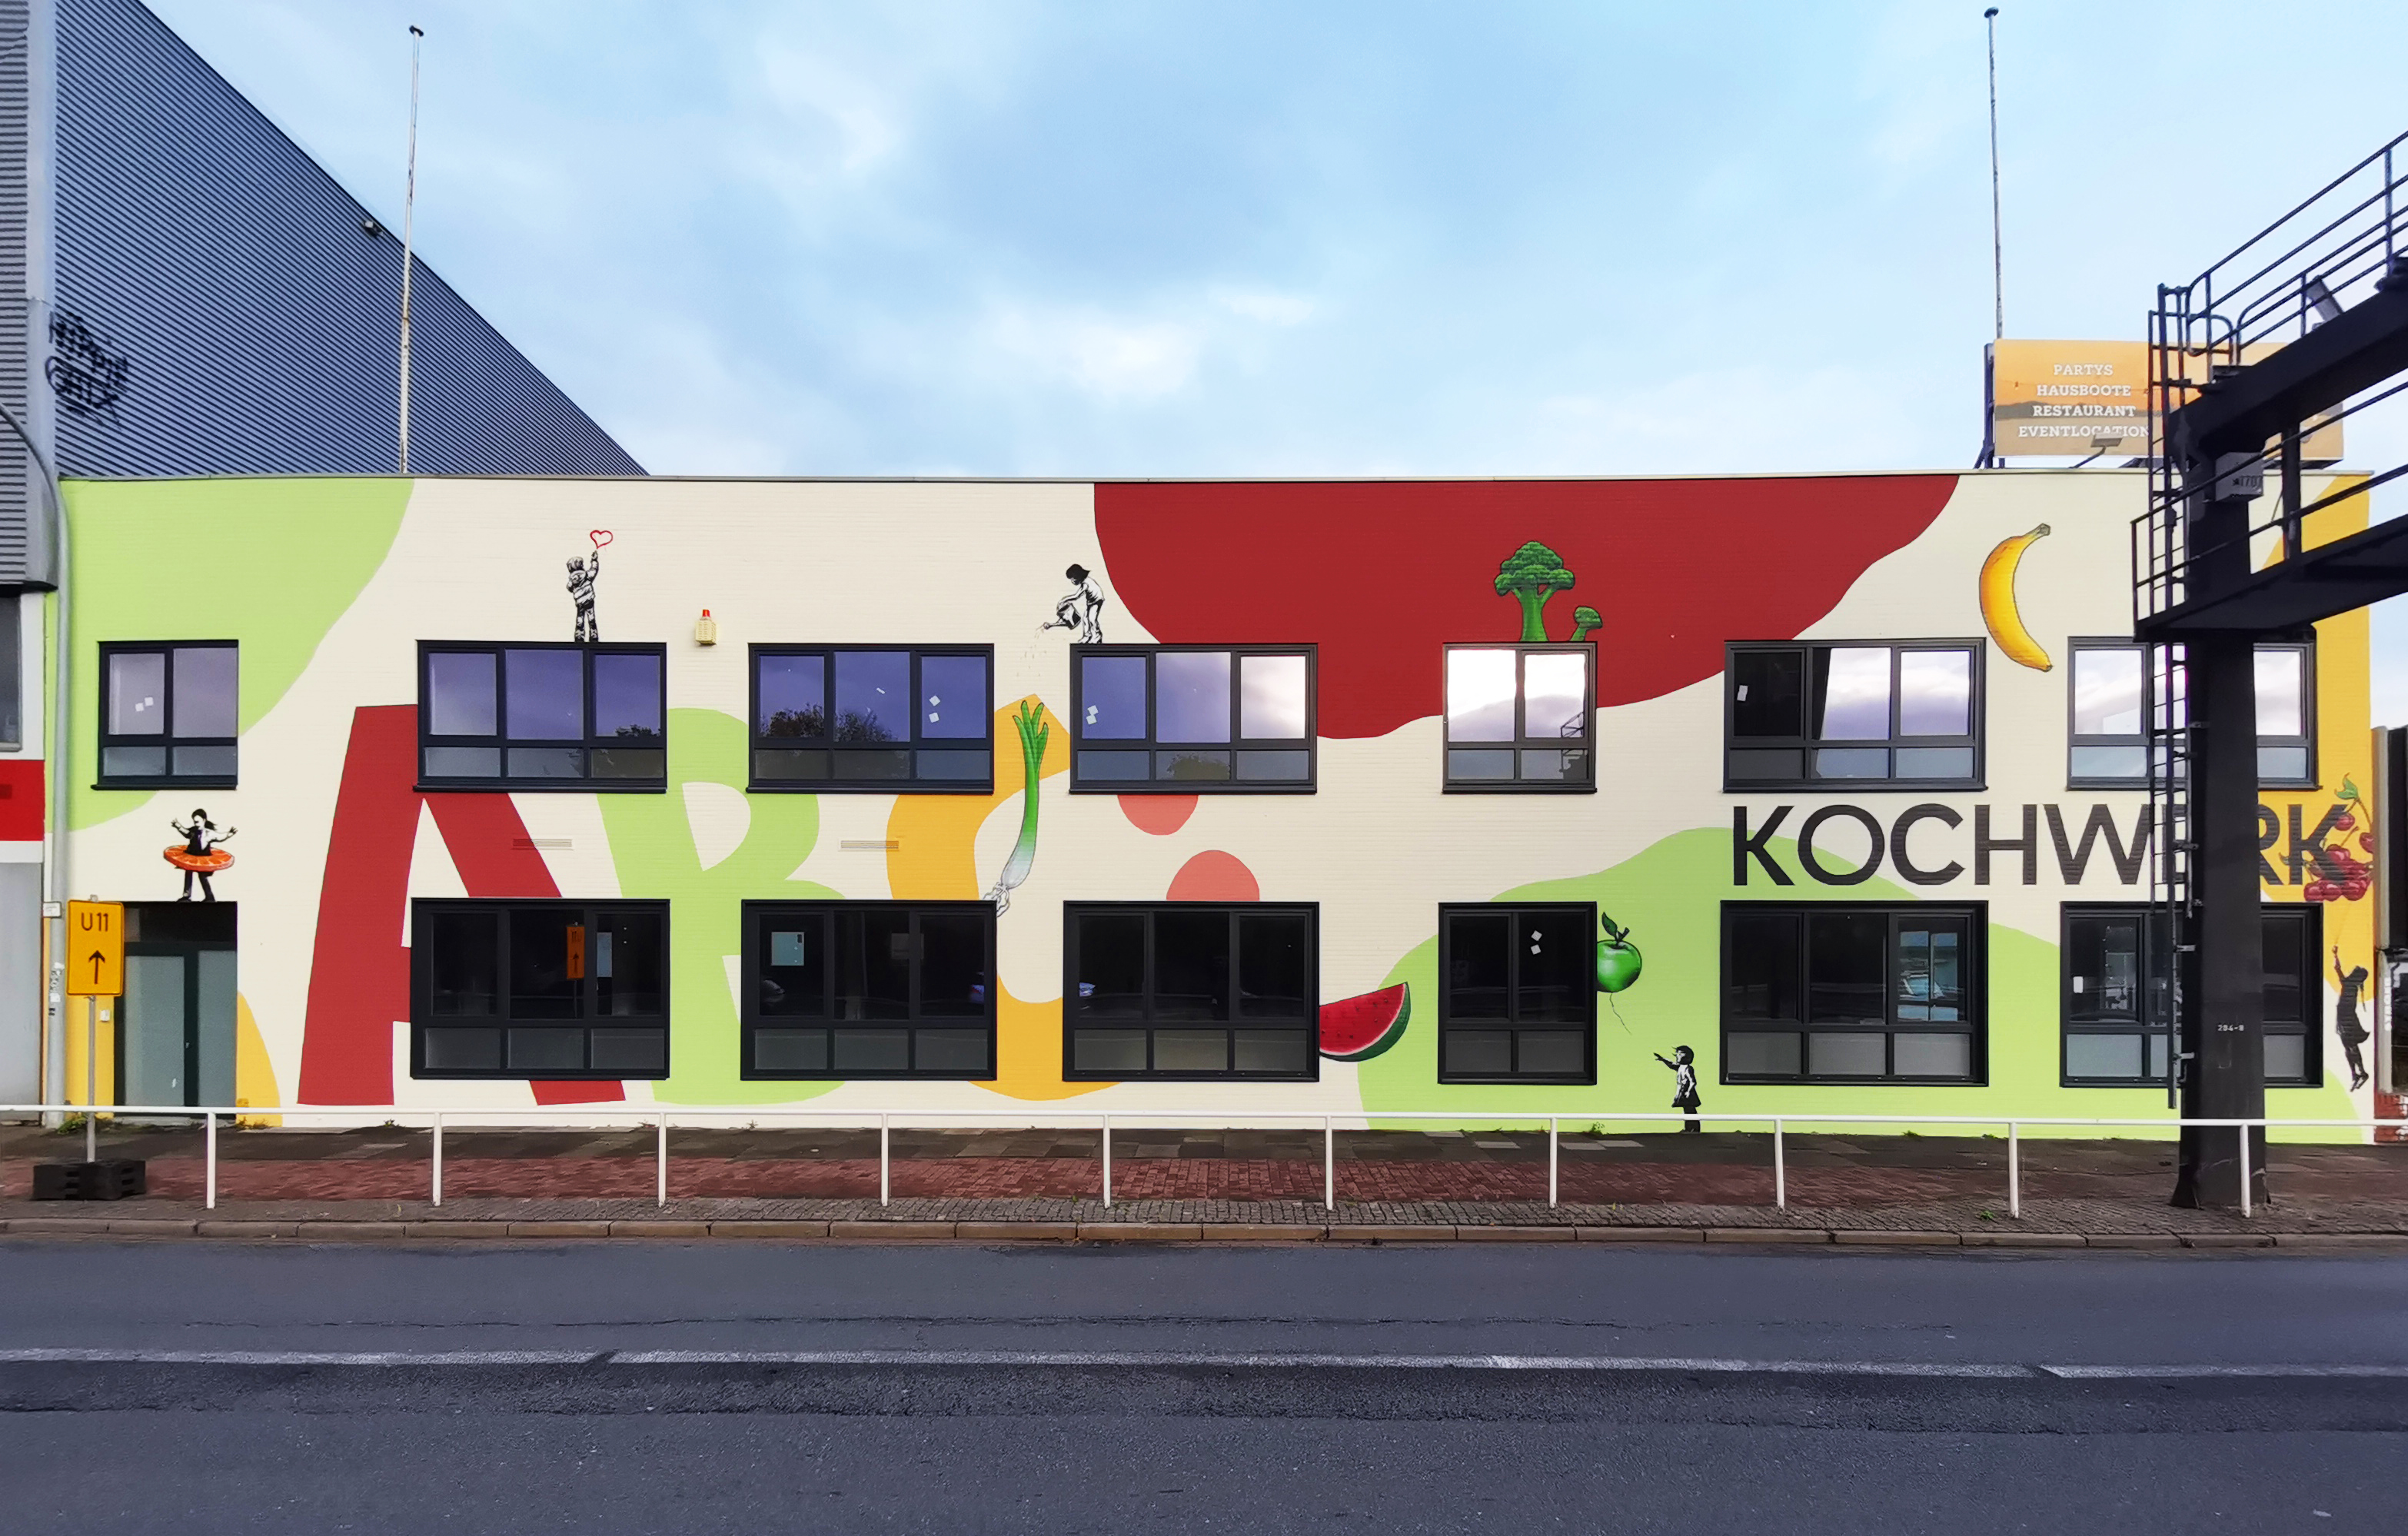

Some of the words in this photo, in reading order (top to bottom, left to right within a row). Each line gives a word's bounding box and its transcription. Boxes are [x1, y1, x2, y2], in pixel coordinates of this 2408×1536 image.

[2054, 364, 2114, 376] PARTYS
[2037, 384, 2131, 397] HAUSBOOTE
[2032, 404, 2136, 417] RESTAURANT
[2018, 425, 2149, 437] EVENTLOCATION
[81, 913, 108, 932] U11
